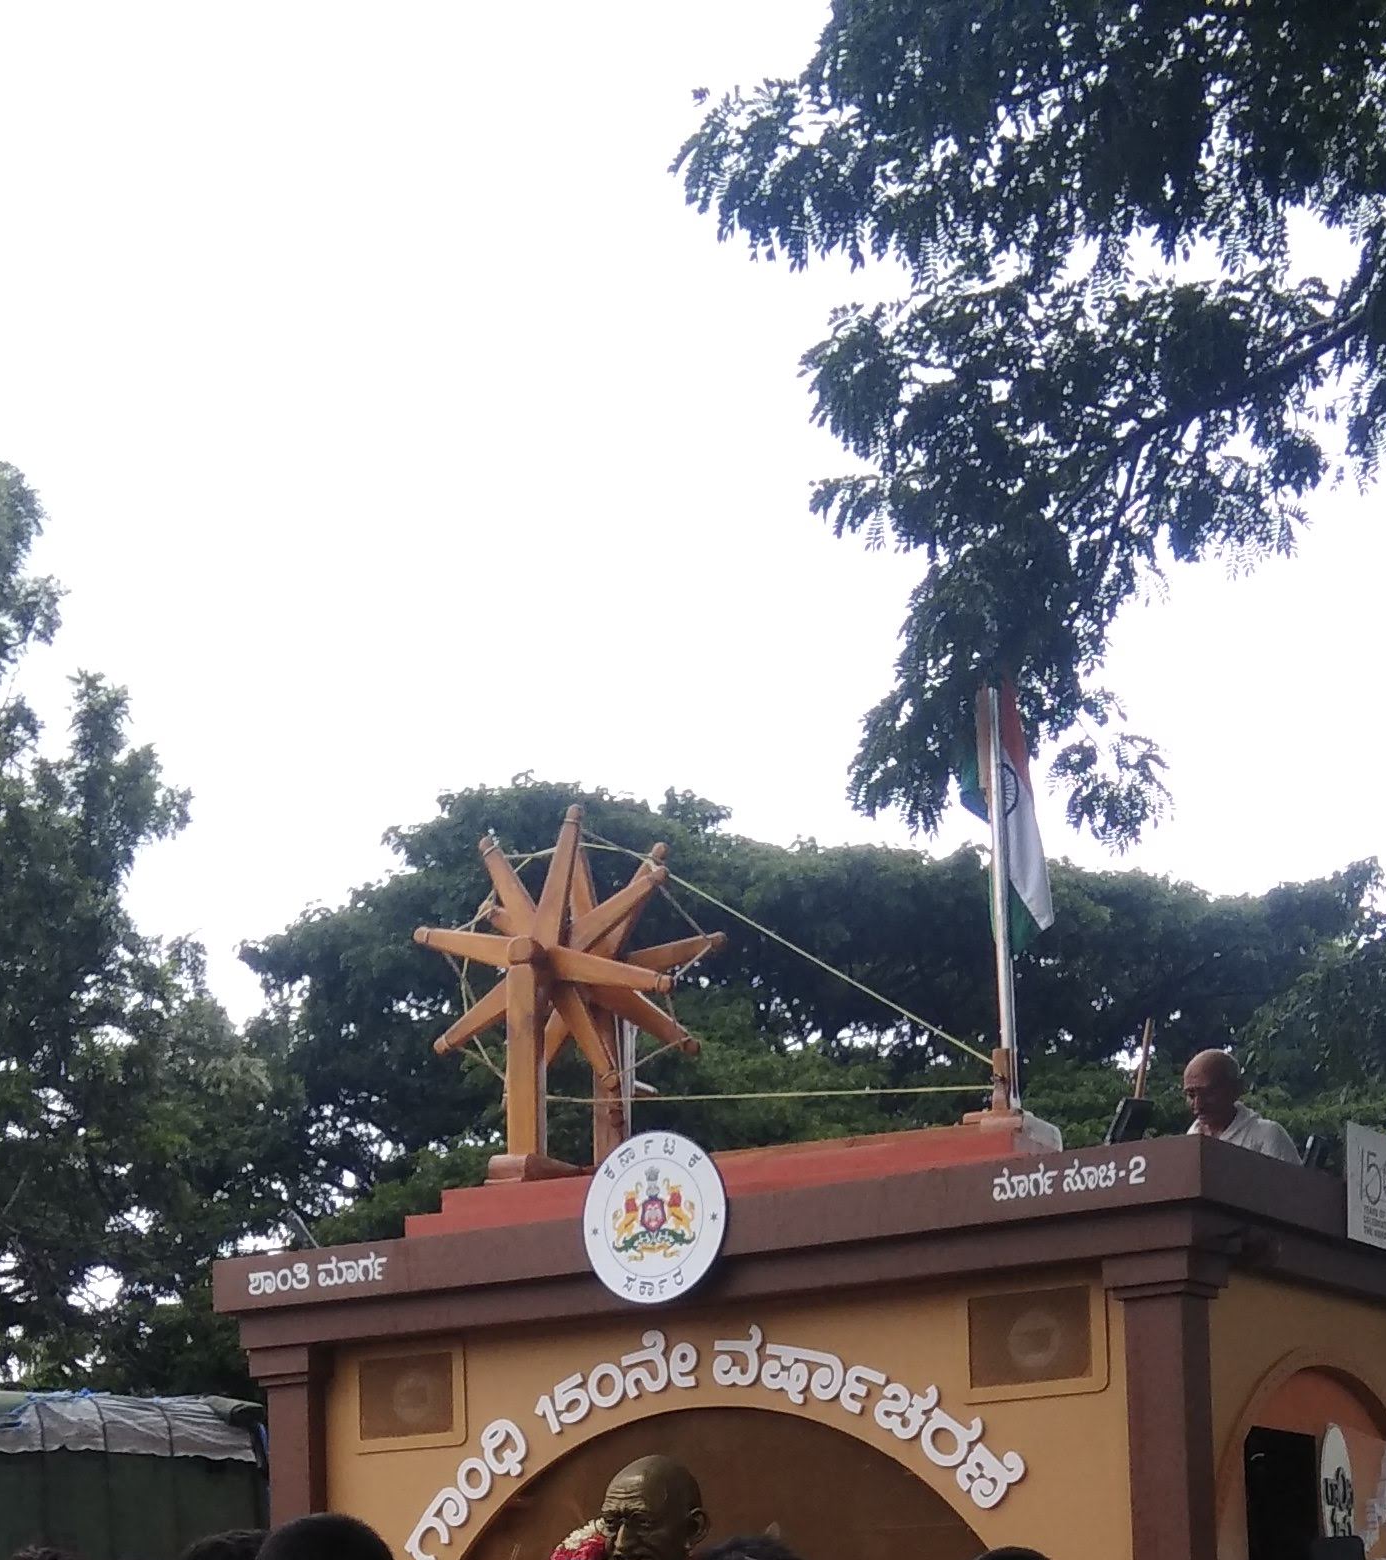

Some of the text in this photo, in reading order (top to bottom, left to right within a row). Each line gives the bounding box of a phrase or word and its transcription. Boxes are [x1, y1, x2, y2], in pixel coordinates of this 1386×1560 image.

[992, 1161, 1059, 1202] ಮಾರ್ಗ
[247, 1251, 388, 1296] ಶಾಂತಿ ಮಾರ್ಗ
[712, 1324, 1027, 1510] ವರ್ಷಾಚರಣೆ
